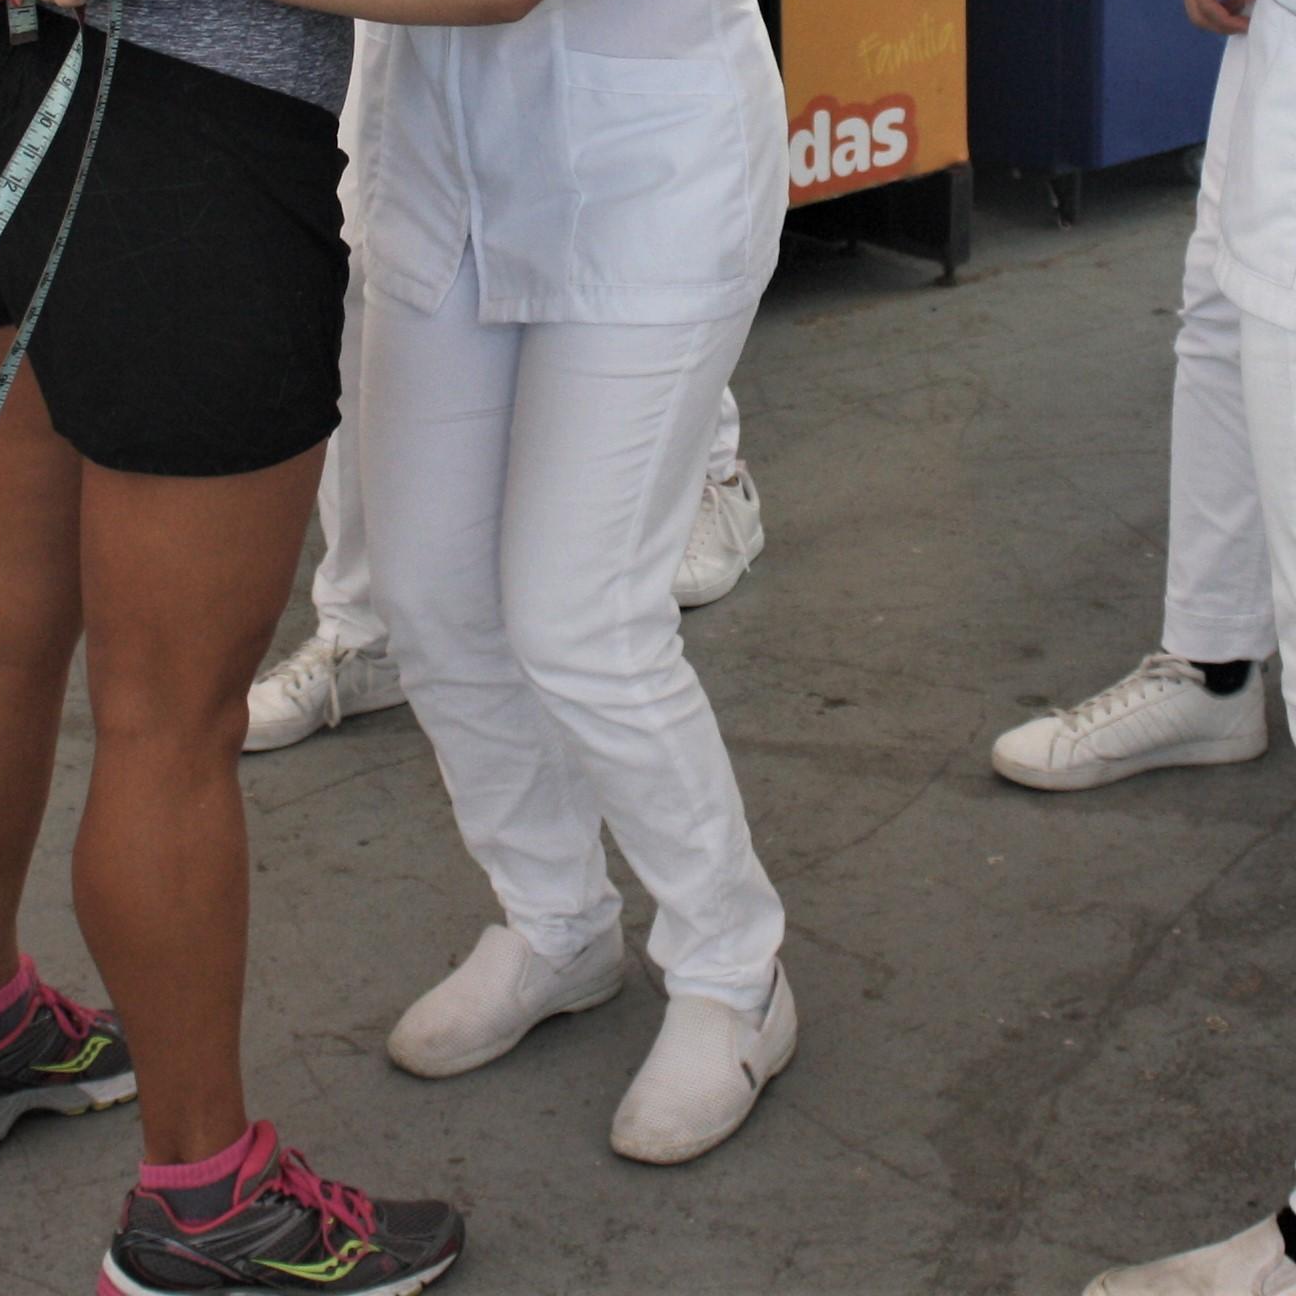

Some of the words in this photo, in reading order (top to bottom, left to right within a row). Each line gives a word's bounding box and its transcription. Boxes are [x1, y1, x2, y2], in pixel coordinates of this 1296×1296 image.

[857, 11, 958, 80] Familia
[40, 112, 56, 128] 10
[23, 144, 39, 159] 11
[4, 176, 22, 192] 12
